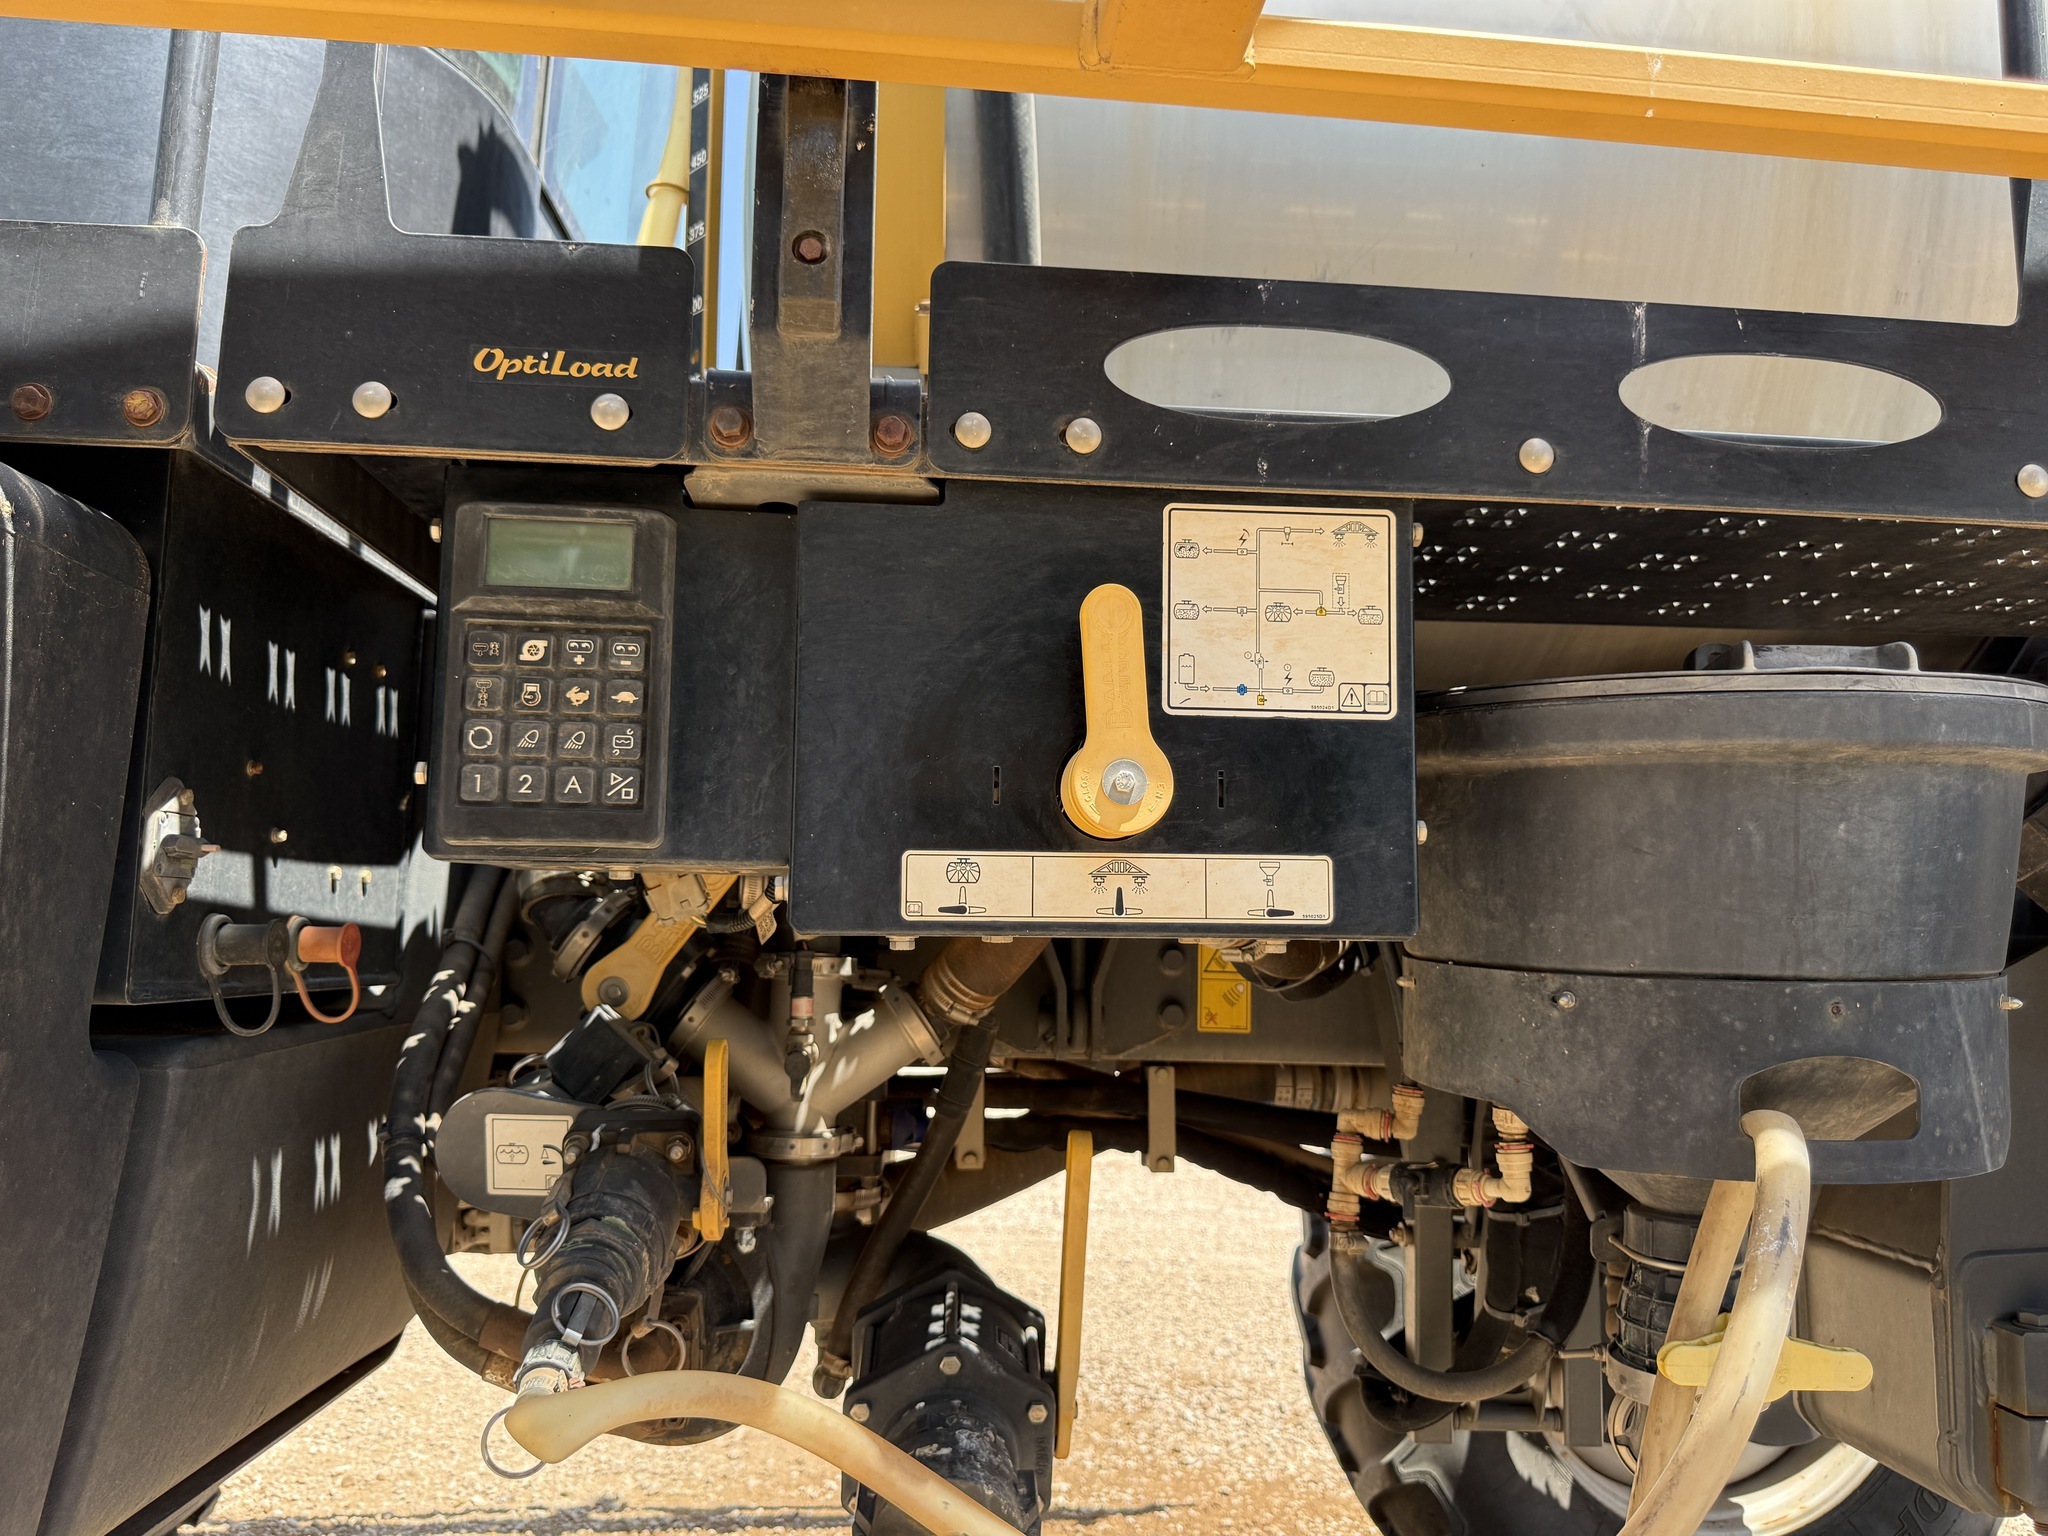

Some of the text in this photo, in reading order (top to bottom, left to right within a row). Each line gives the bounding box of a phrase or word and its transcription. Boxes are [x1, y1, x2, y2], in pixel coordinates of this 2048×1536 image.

[693, 83, 709, 104] 525
[691, 150, 707, 170] 450
[688, 221, 705, 242] 375
[692, 294, 703, 312] 00
[473, 347, 639, 381] OptiLoad
[473, 773, 481, 793] 1
[518, 774, 533, 794] 2
[564, 776, 583, 795] A
